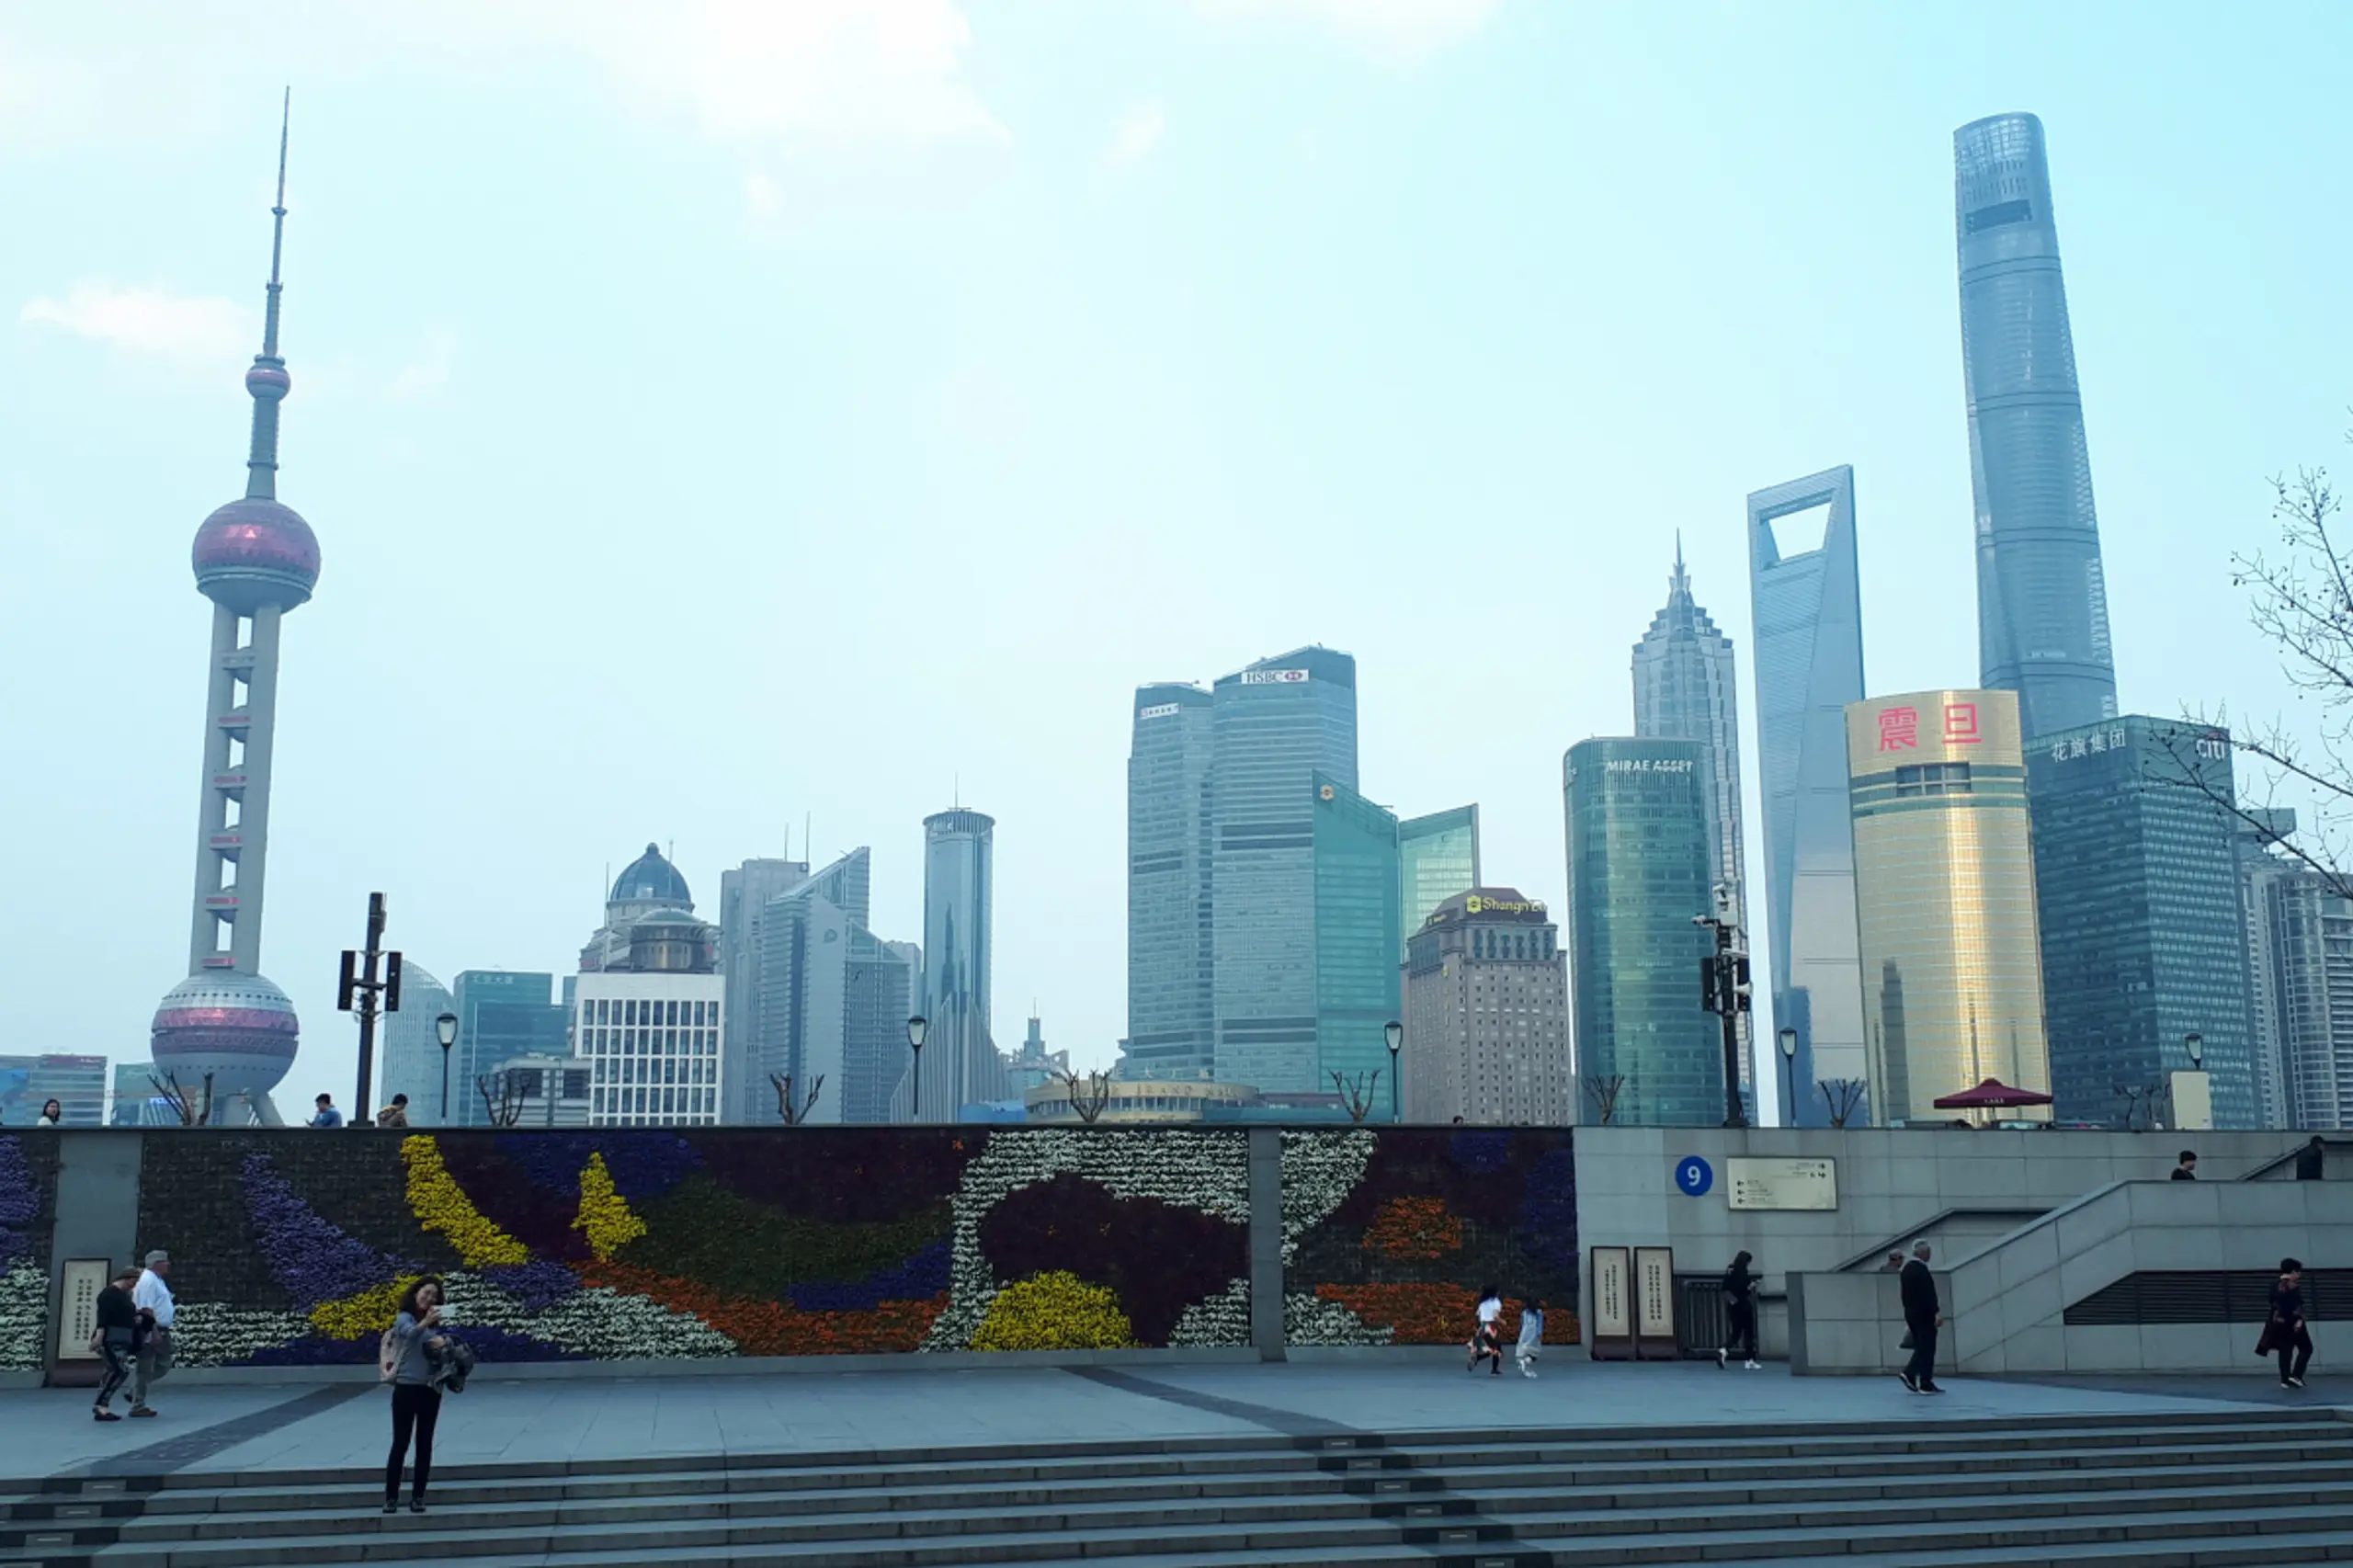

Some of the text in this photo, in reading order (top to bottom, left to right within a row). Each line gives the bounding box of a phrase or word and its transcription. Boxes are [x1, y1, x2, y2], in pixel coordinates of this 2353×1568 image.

[1246, 672, 1284, 683] HSBC
[1879, 706, 1983, 751] 震旦
[2052, 728, 2127, 763] 花旗集团
[1606, 760, 1693, 773] MIRAE ASSET
[1688, 1165, 1701, 1187] 9
